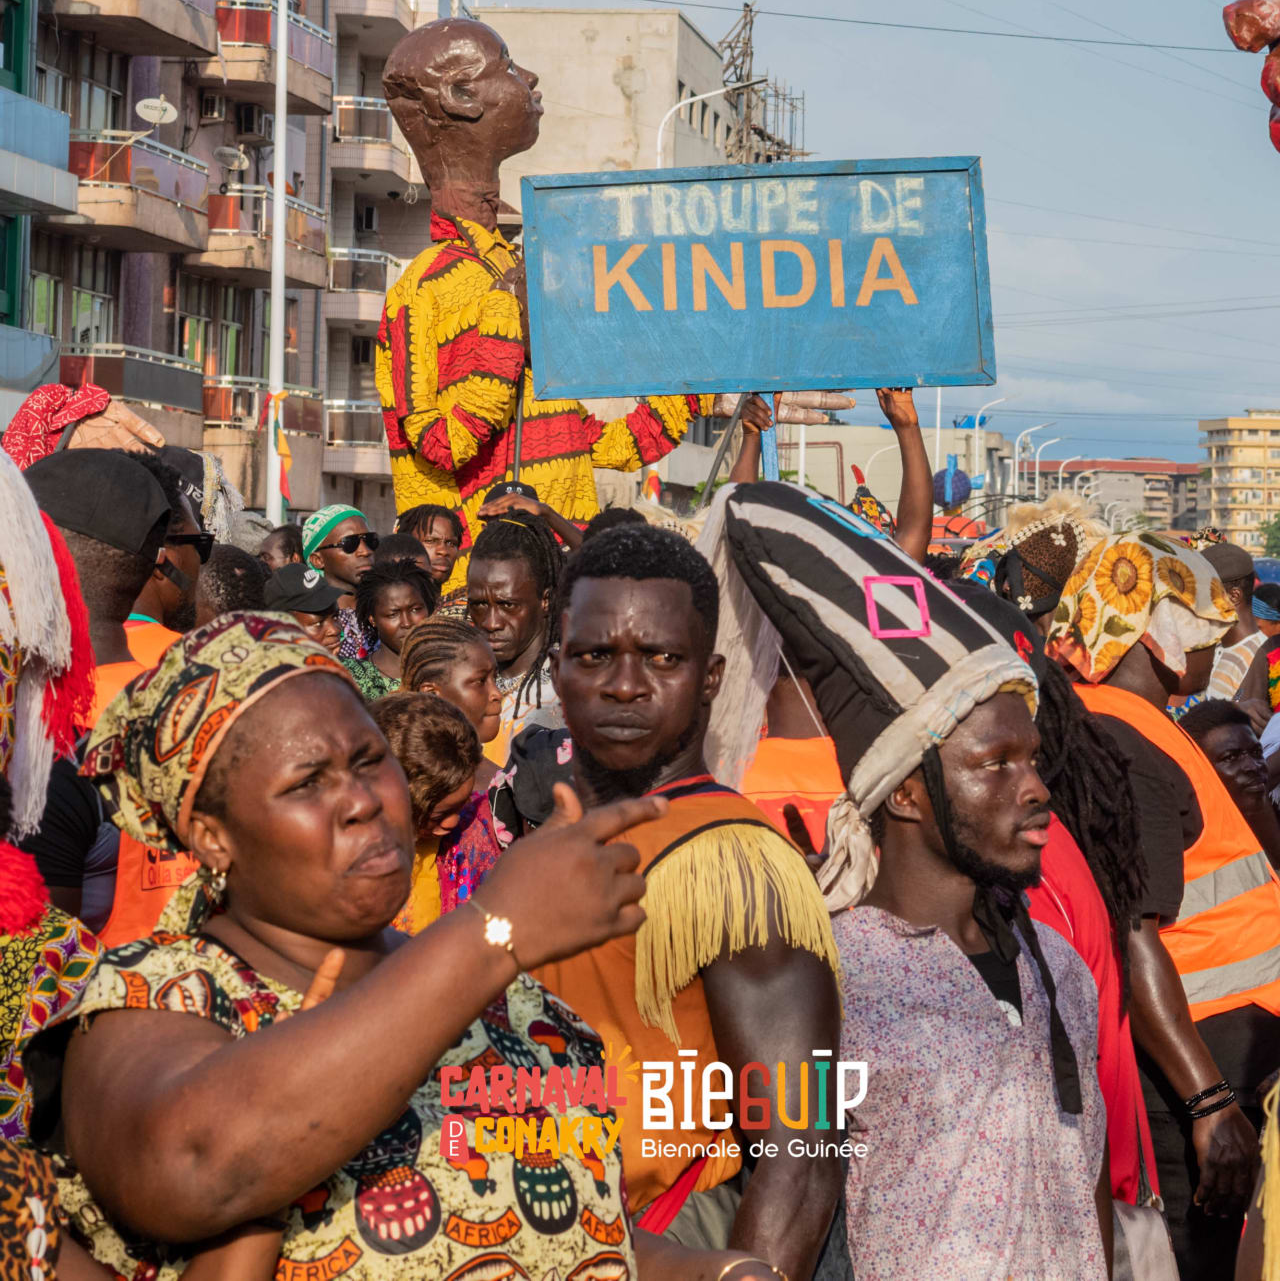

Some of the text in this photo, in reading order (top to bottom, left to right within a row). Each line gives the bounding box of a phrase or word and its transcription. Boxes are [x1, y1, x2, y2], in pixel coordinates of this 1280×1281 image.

[602, 177, 925, 237] TROUPE DE
[592, 237, 920, 313] KINDIA
[449, 1215, 519, 1245] AFRICA
